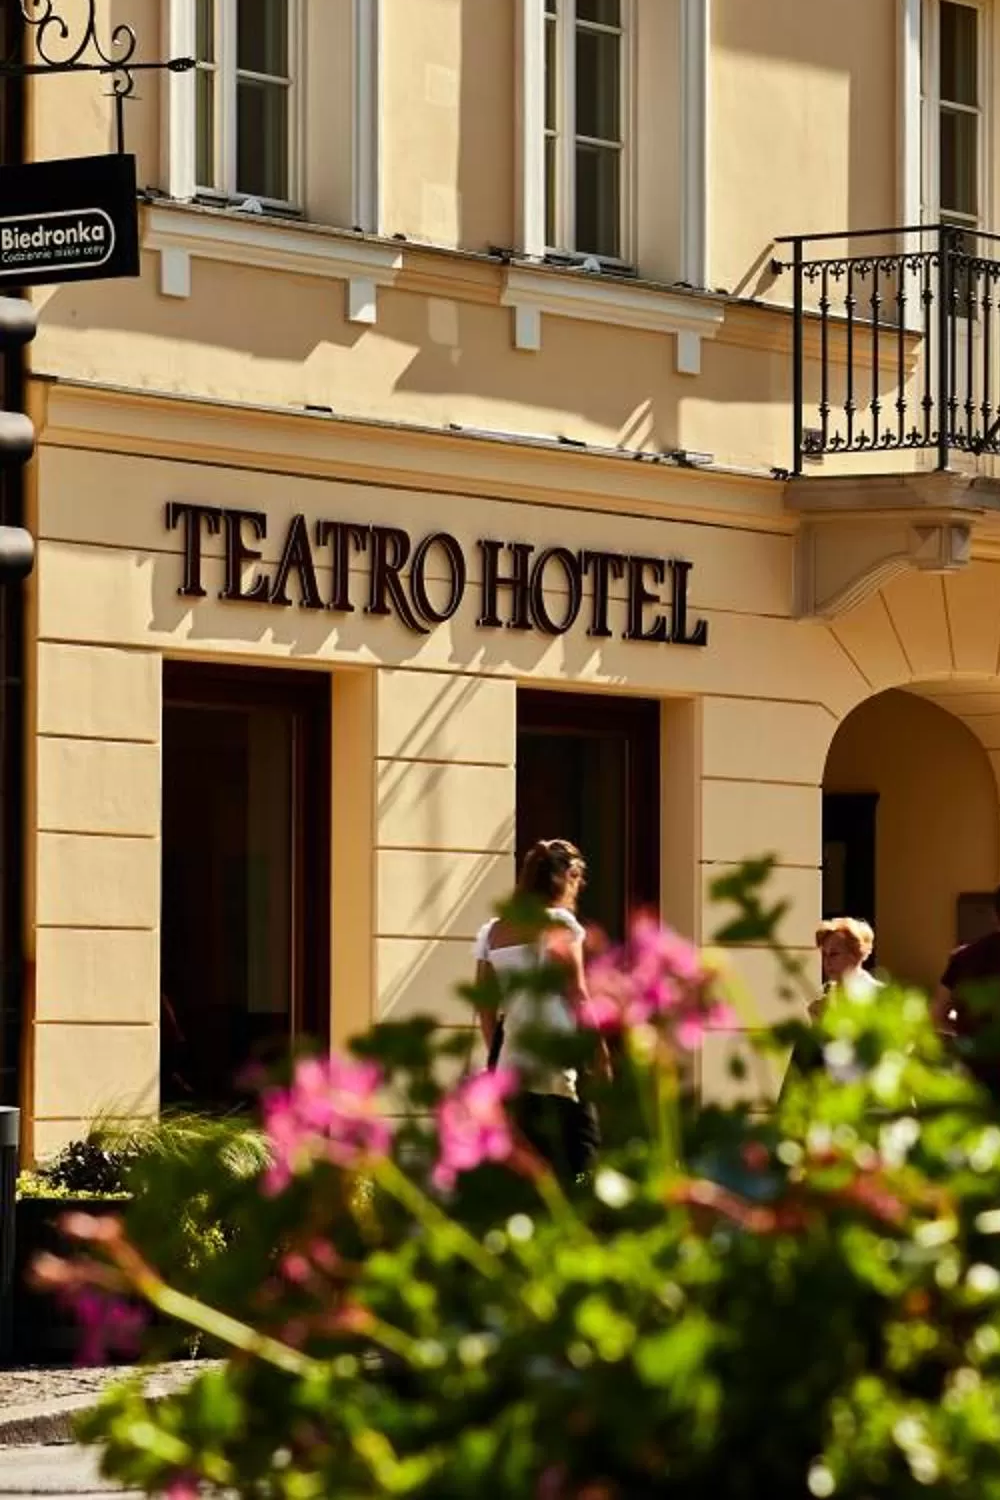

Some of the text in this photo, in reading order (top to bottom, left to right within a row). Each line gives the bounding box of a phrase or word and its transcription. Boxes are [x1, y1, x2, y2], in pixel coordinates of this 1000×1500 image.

[1, 220, 105, 250] Biedronka
[165, 502, 708, 646] TEATRO HOTEL
